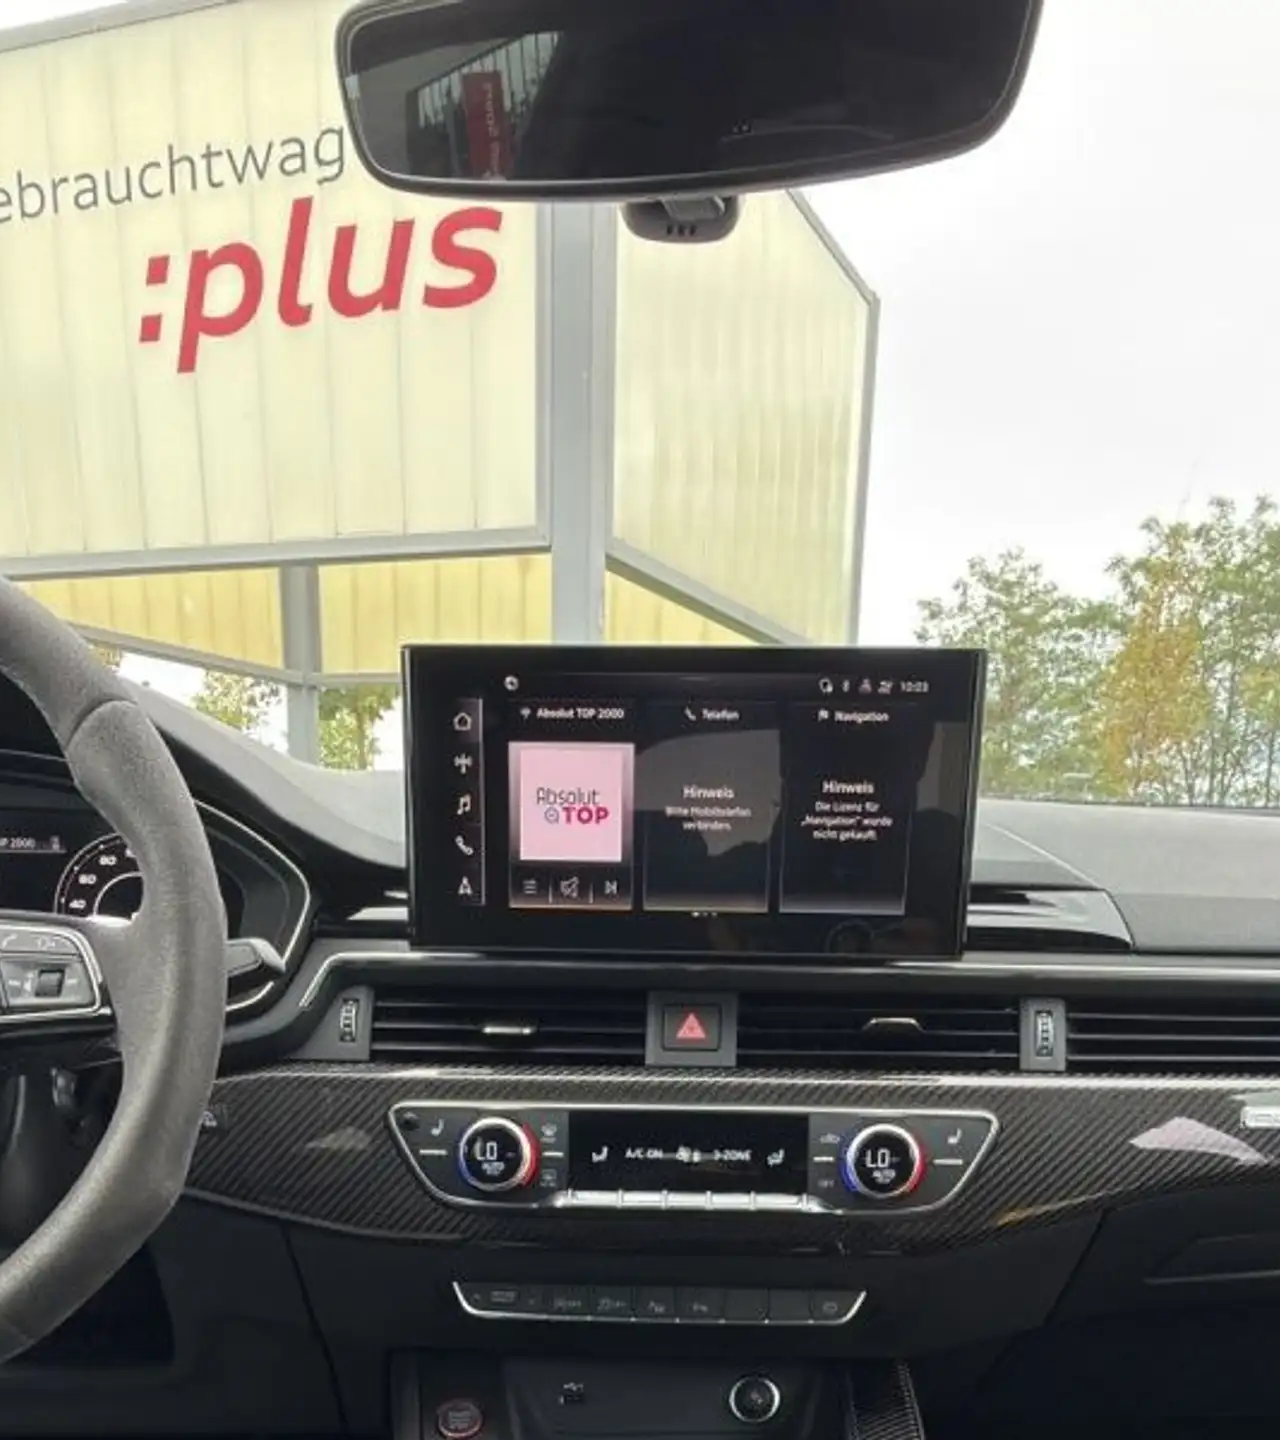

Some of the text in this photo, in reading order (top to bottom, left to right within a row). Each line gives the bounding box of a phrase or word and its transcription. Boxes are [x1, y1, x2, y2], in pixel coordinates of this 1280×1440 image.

[140, 196, 503, 373] :plus
[536, 707, 574, 719] Absolut
[576, 707, 596, 719] TOP
[701, 707, 740, 721] Telefon
[834, 711, 890, 723] Navigation
[683, 785, 735, 799] Hinweis
[822, 780, 875, 794] Hinweis
[536, 786, 600, 805] Absolut
[814, 801, 831, 812] Die
[561, 806, 610, 825] TOP
[862, 816, 893, 827] wurde
[812, 829, 838, 840] nicht
[625, 1147, 645, 1159] A/C
[865, 1148, 891, 1168] LO
